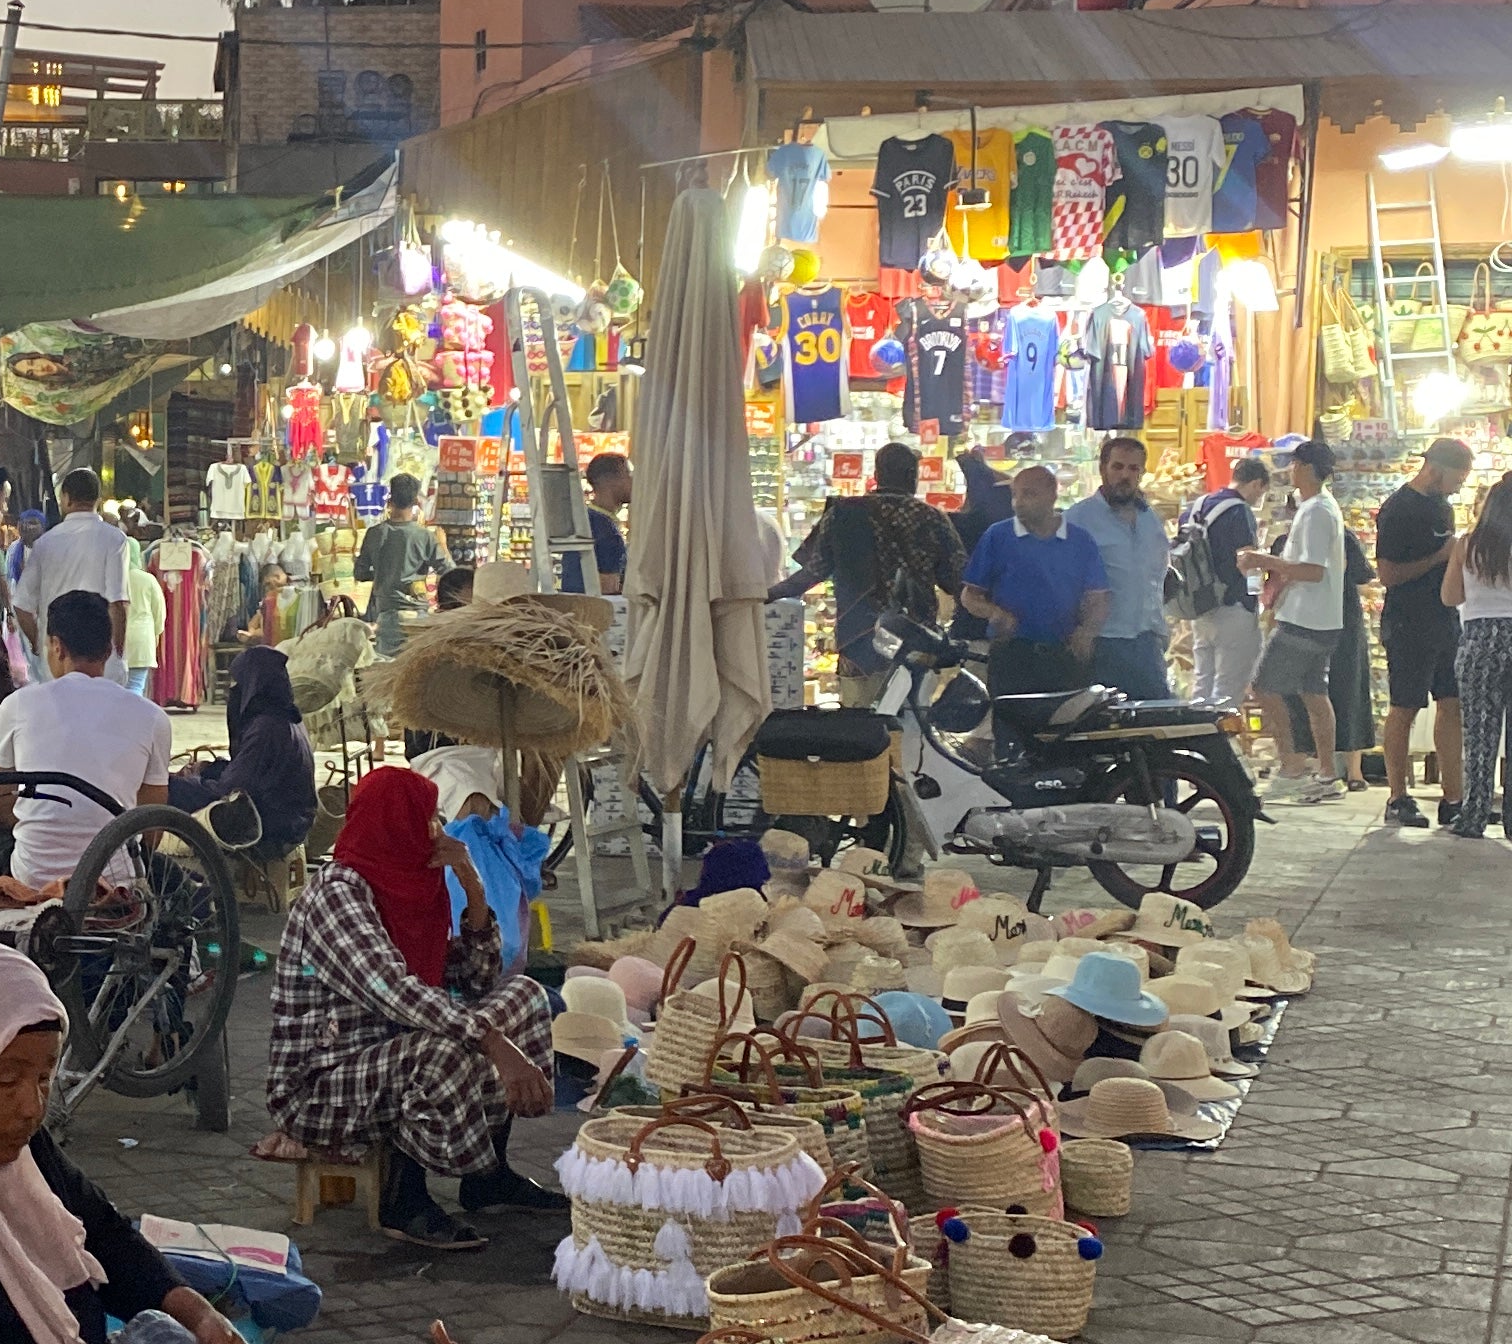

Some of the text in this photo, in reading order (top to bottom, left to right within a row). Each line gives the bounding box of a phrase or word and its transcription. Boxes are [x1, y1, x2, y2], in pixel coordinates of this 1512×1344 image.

[894, 173, 936, 193] PARIS
[1166, 156, 1199, 189] 30
[903, 193, 927, 218] 23
[796, 311, 835, 329] CURRY
[794, 327, 841, 366] 30
[918, 330, 962, 352] BROOKLYN
[933, 350, 947, 376] 7
[1026, 341, 1037, 372] 9
